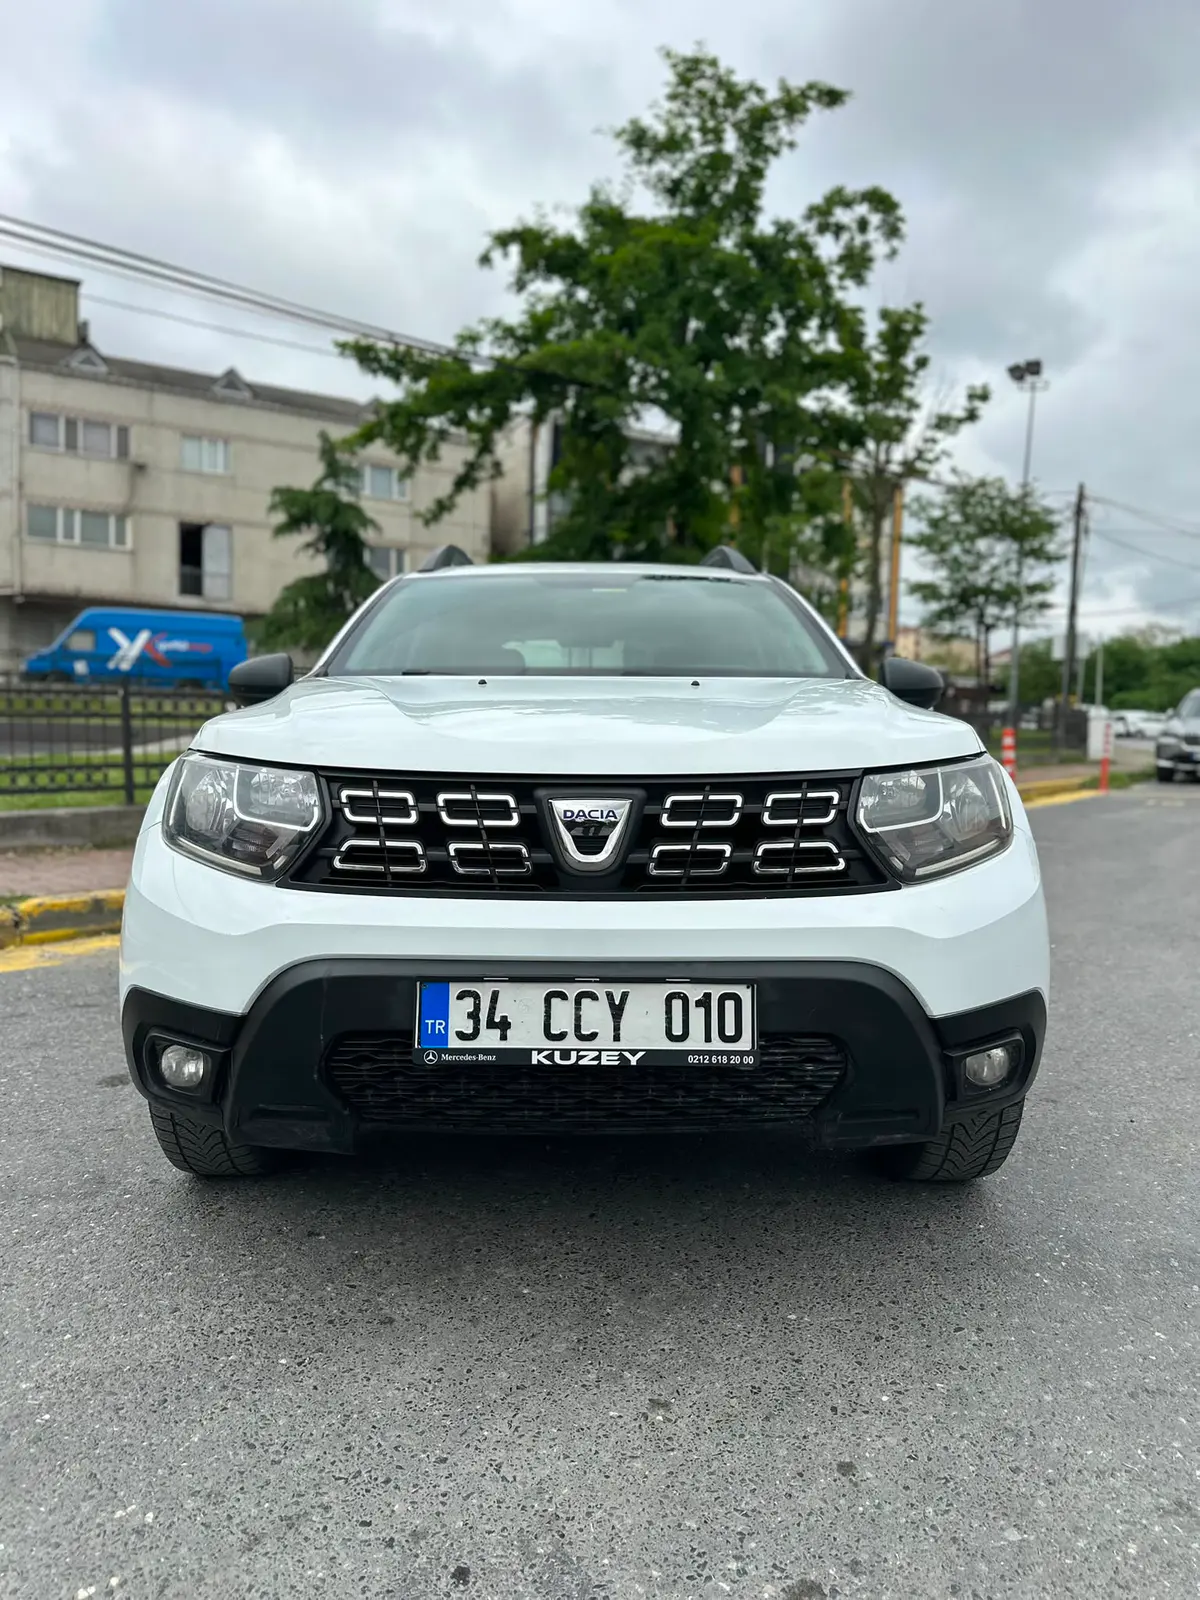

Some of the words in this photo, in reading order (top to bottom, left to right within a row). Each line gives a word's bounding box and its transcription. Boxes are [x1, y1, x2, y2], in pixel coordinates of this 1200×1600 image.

[563, 809, 618, 819] DACIA
[455, 990, 512, 1041] 34
[543, 989, 631, 1042] CCY
[665, 990, 743, 1043] 010
[425, 1020, 446, 1034] TR
[441, 1053, 496, 1061] Mercedes-Benz
[531, 1050, 647, 1066] KUZEY
[688, 1054, 710, 1064] 0212
[712, 1054, 728, 1064] 618
[730, 1055, 741, 1064] 20
[743, 1055, 754, 1064] 00
